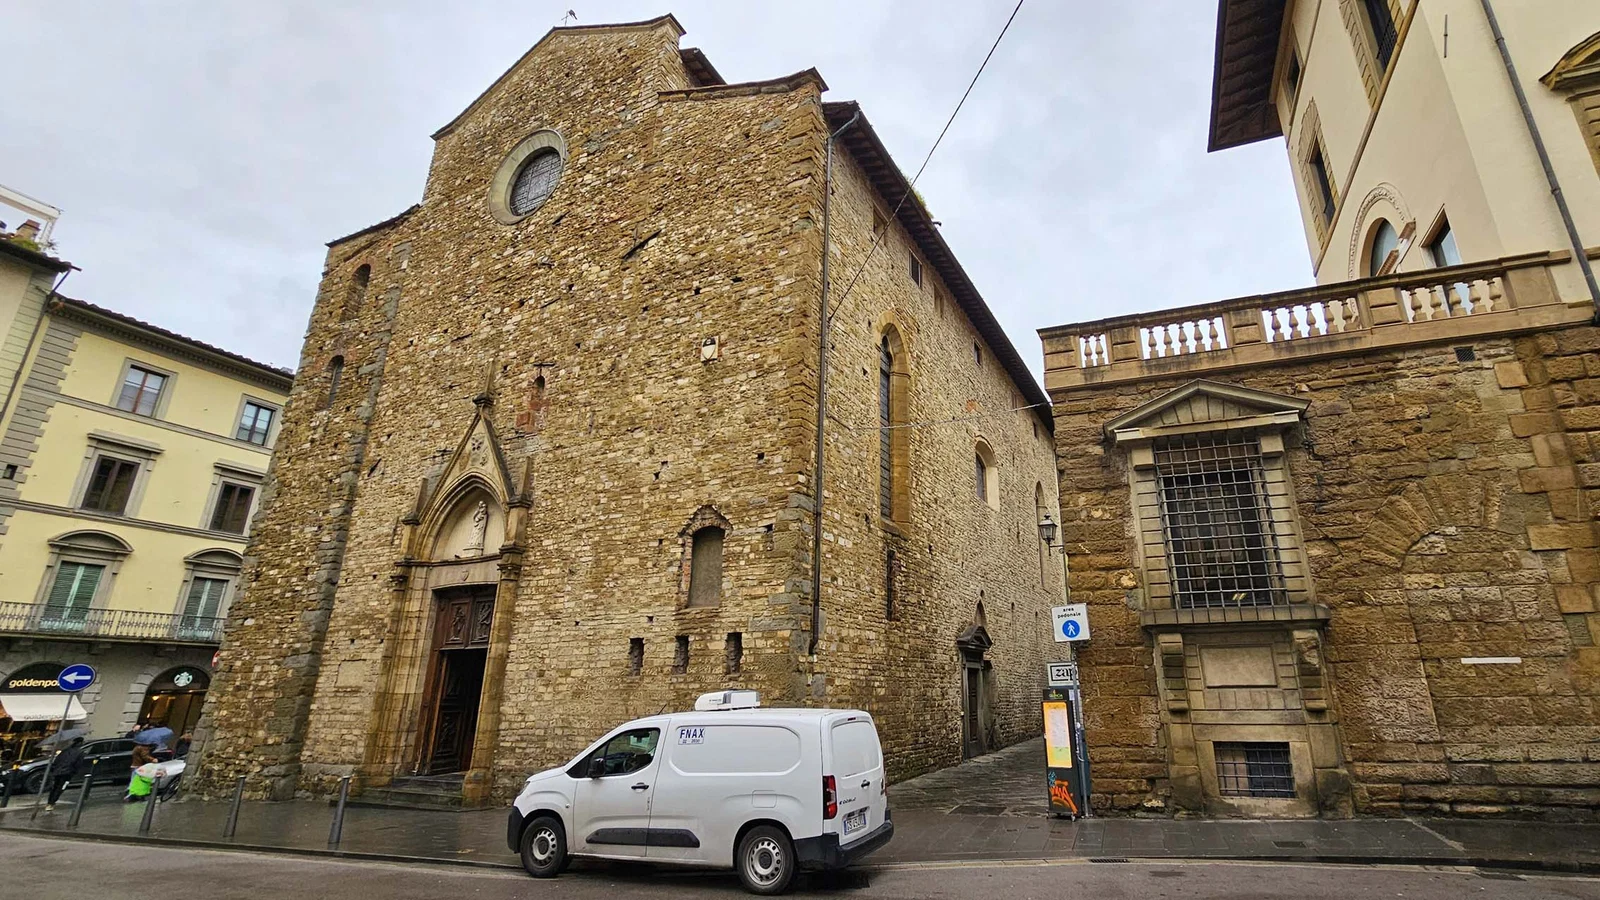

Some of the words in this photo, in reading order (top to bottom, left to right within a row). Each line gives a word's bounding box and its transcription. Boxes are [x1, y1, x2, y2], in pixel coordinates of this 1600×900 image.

[1057, 611, 1081, 619] pedonale
[9, 679, 60, 688] goldenpo
[680, 728, 704, 738] FNAX
